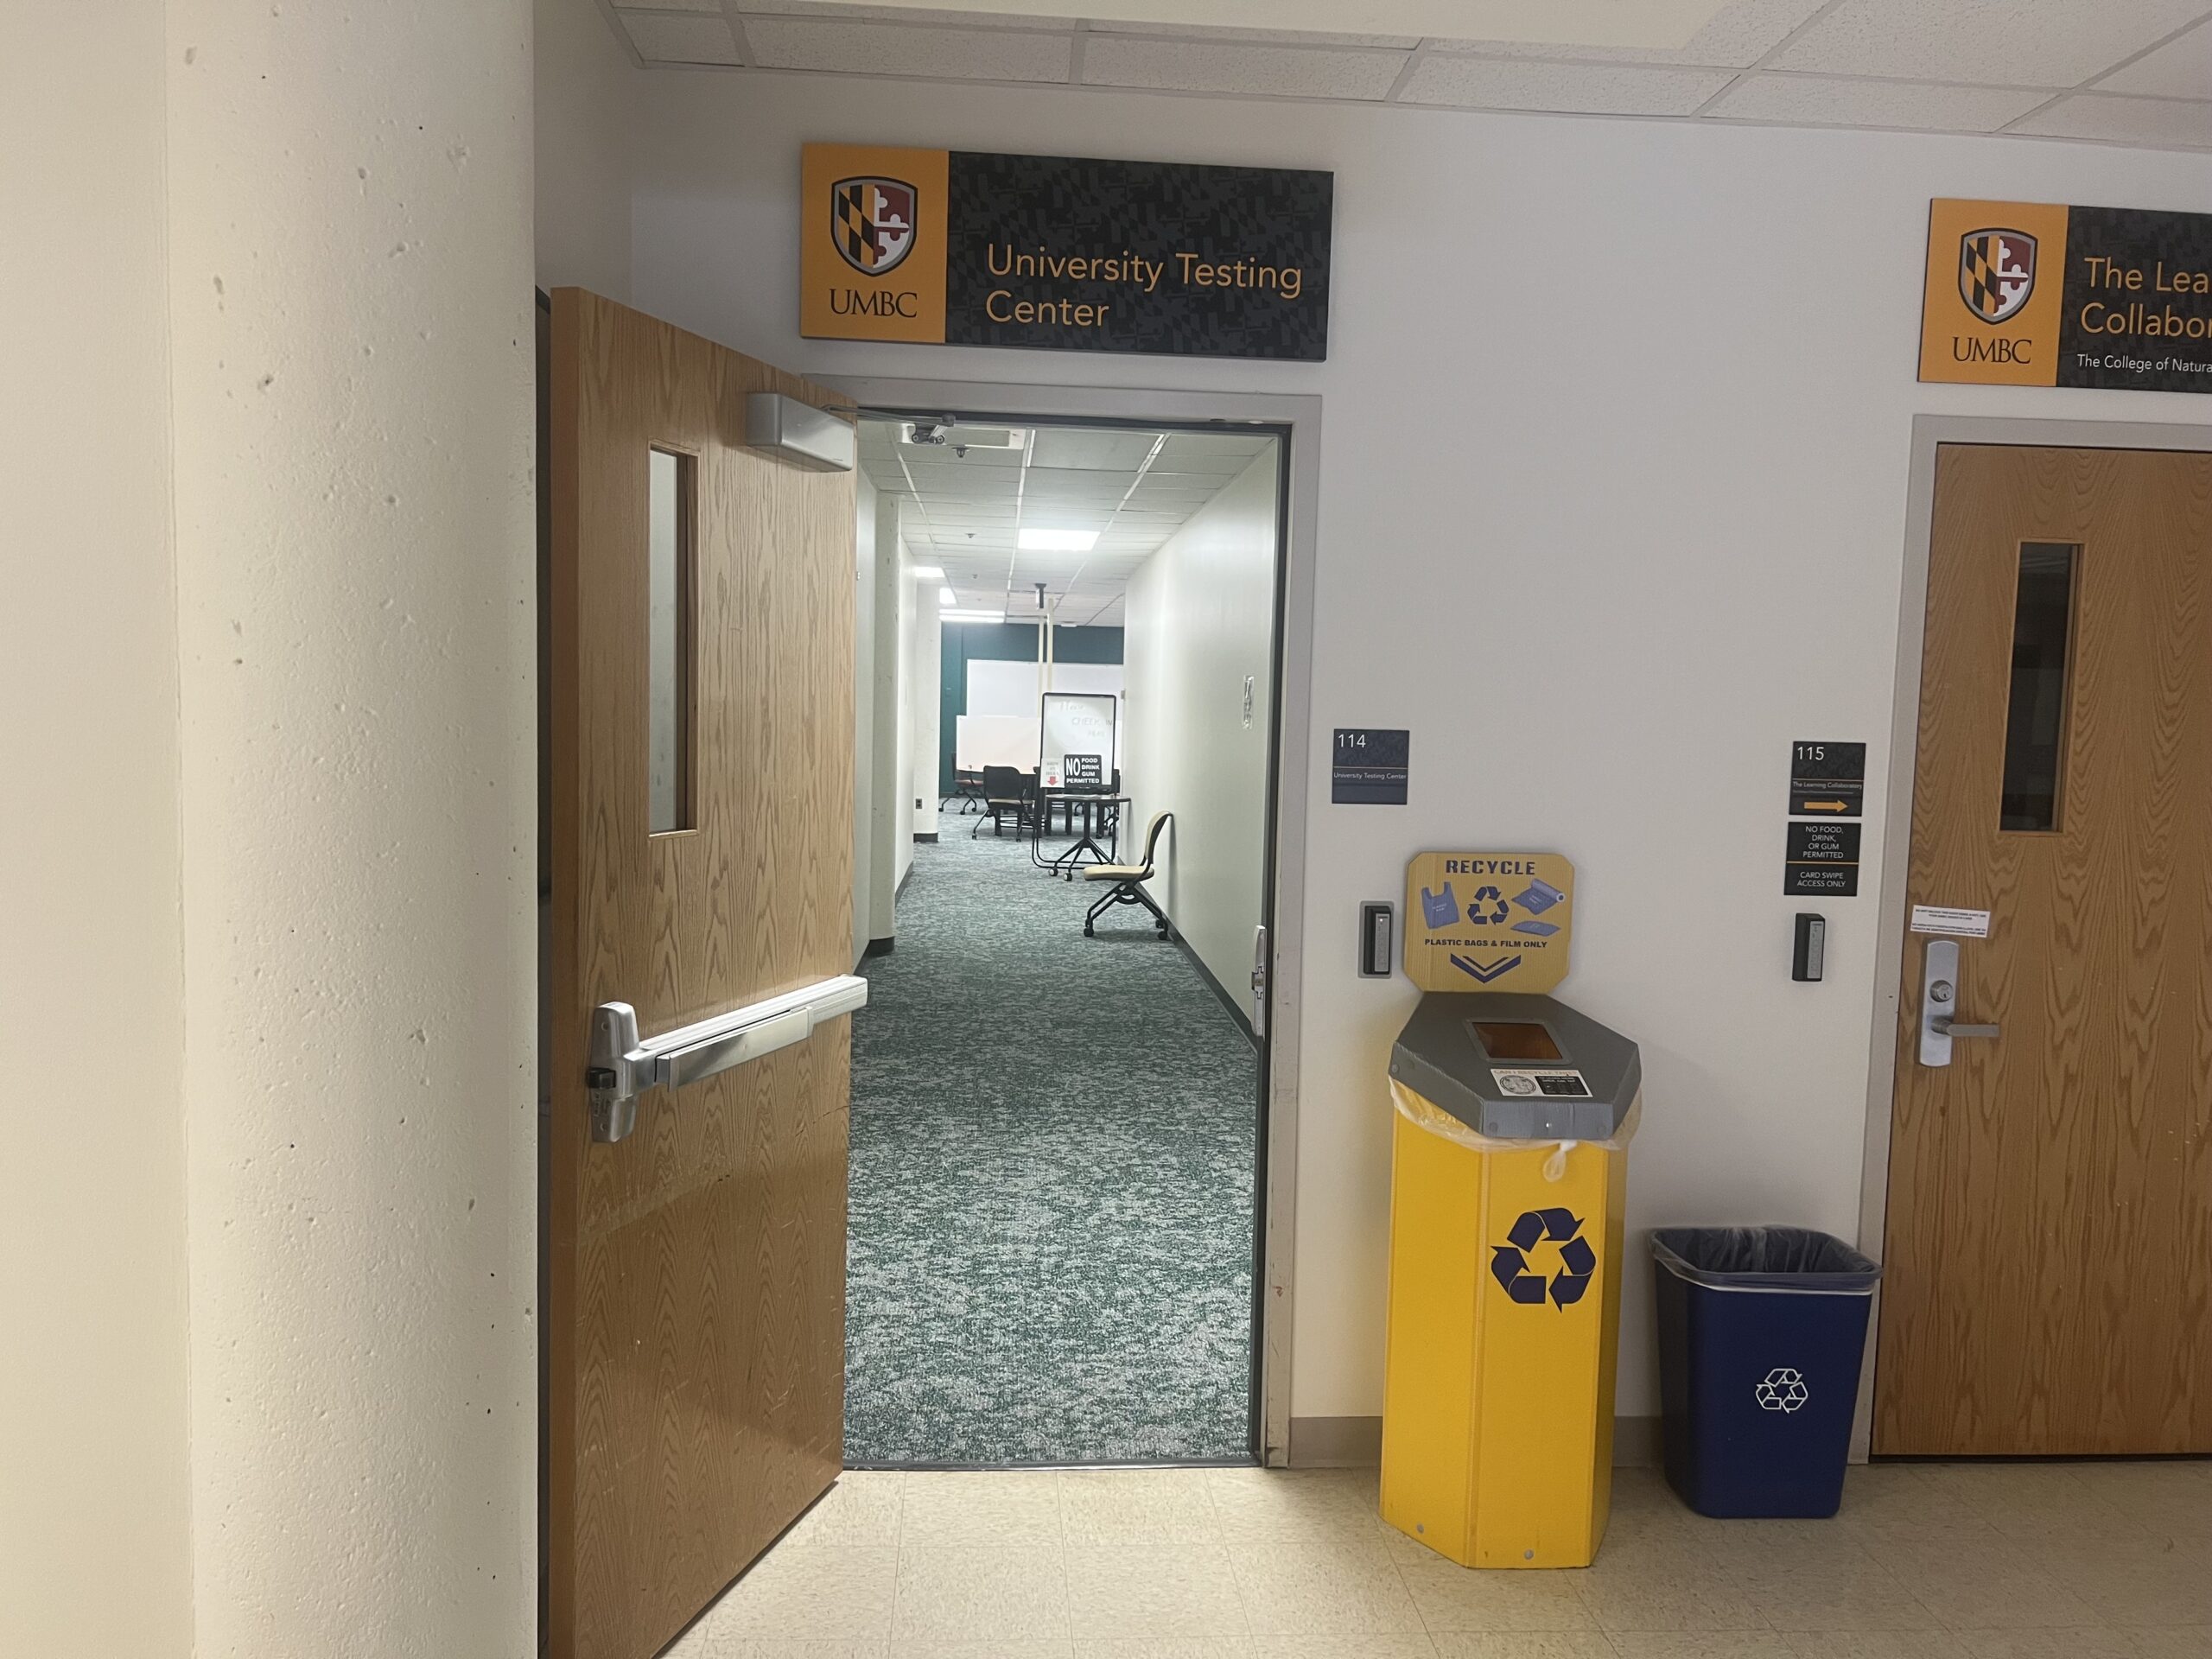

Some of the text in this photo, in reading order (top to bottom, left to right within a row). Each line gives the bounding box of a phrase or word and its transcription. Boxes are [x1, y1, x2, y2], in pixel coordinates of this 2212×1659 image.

[986, 243, 1303, 300] University Testing
[2084, 257, 2143, 290] The
[829, 288, 918, 319] UMBC
[985, 290, 1109, 328] Center
[1952, 336, 2032, 364] UMBC
[2077, 353, 2100, 367] The
[2104, 355, 2152, 373] College
[2156, 357, 2170, 370] of
[1338, 734, 1366, 748] 114
[1797, 746, 1825, 760] 115
[1065, 758, 1081, 777] NO
[1811, 834, 1836, 842] DRINK,
[1802, 850, 1844, 859] PERMITTED
[1446, 860, 1535, 875] RECYCLE
